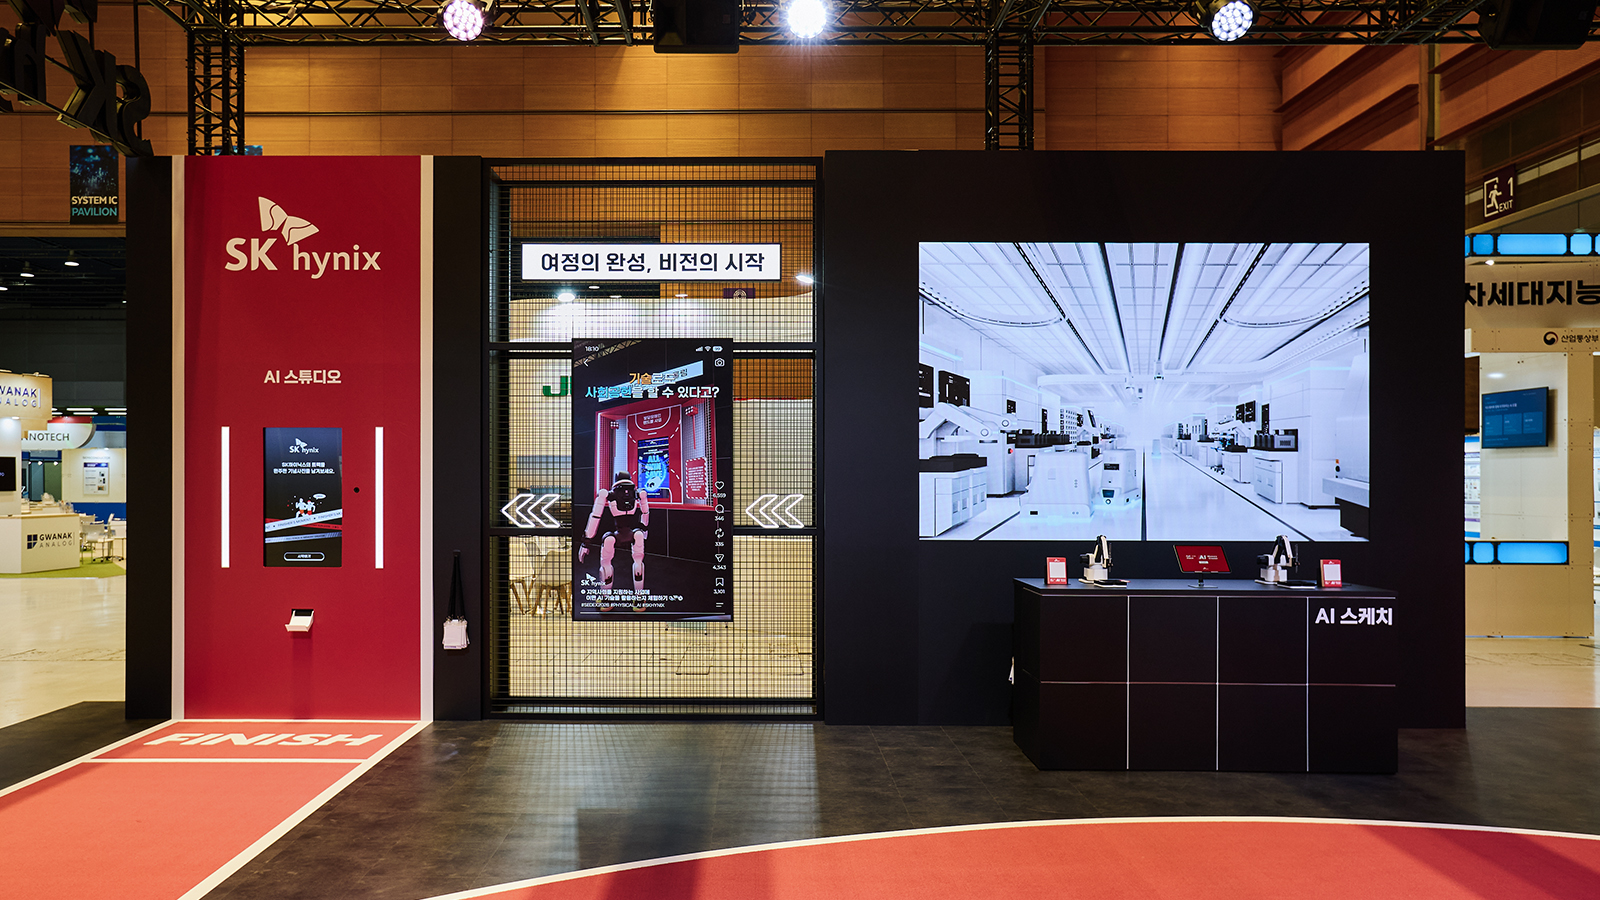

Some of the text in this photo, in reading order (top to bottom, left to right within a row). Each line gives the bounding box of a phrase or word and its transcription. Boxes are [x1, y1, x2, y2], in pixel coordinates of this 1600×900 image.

[1507, 176, 1514, 197] 1
[71, 195, 118, 205] SYSTEM IC
[1499, 199, 1514, 213] EXIT
[71, 206, 118, 217] PAVILION
[224, 237, 382, 280] SK hynix
[541, 252, 765, 274] 여정의 완성, 비전의 시작
[263, 369, 342, 385] AI 스튜디오
[542, 375, 573, 397] J
[584, 386, 643, 399] 사회공헌을
[647, 386, 660, 399] 할
[661, 386, 675, 399] 수
[677, 386, 720, 399] 있다고?
[0, 397, 37, 408] ALOG
[21, 432, 70, 442] NOTECH
[289, 445, 320, 455] SK hynix
[39, 532, 73, 542] GWANAK
[39, 540, 73, 549] ANALOG
[580, 579, 590, 587] SK
[1314, 607, 1393, 626] AI 스케치
[143, 733, 383, 746] FINISH
